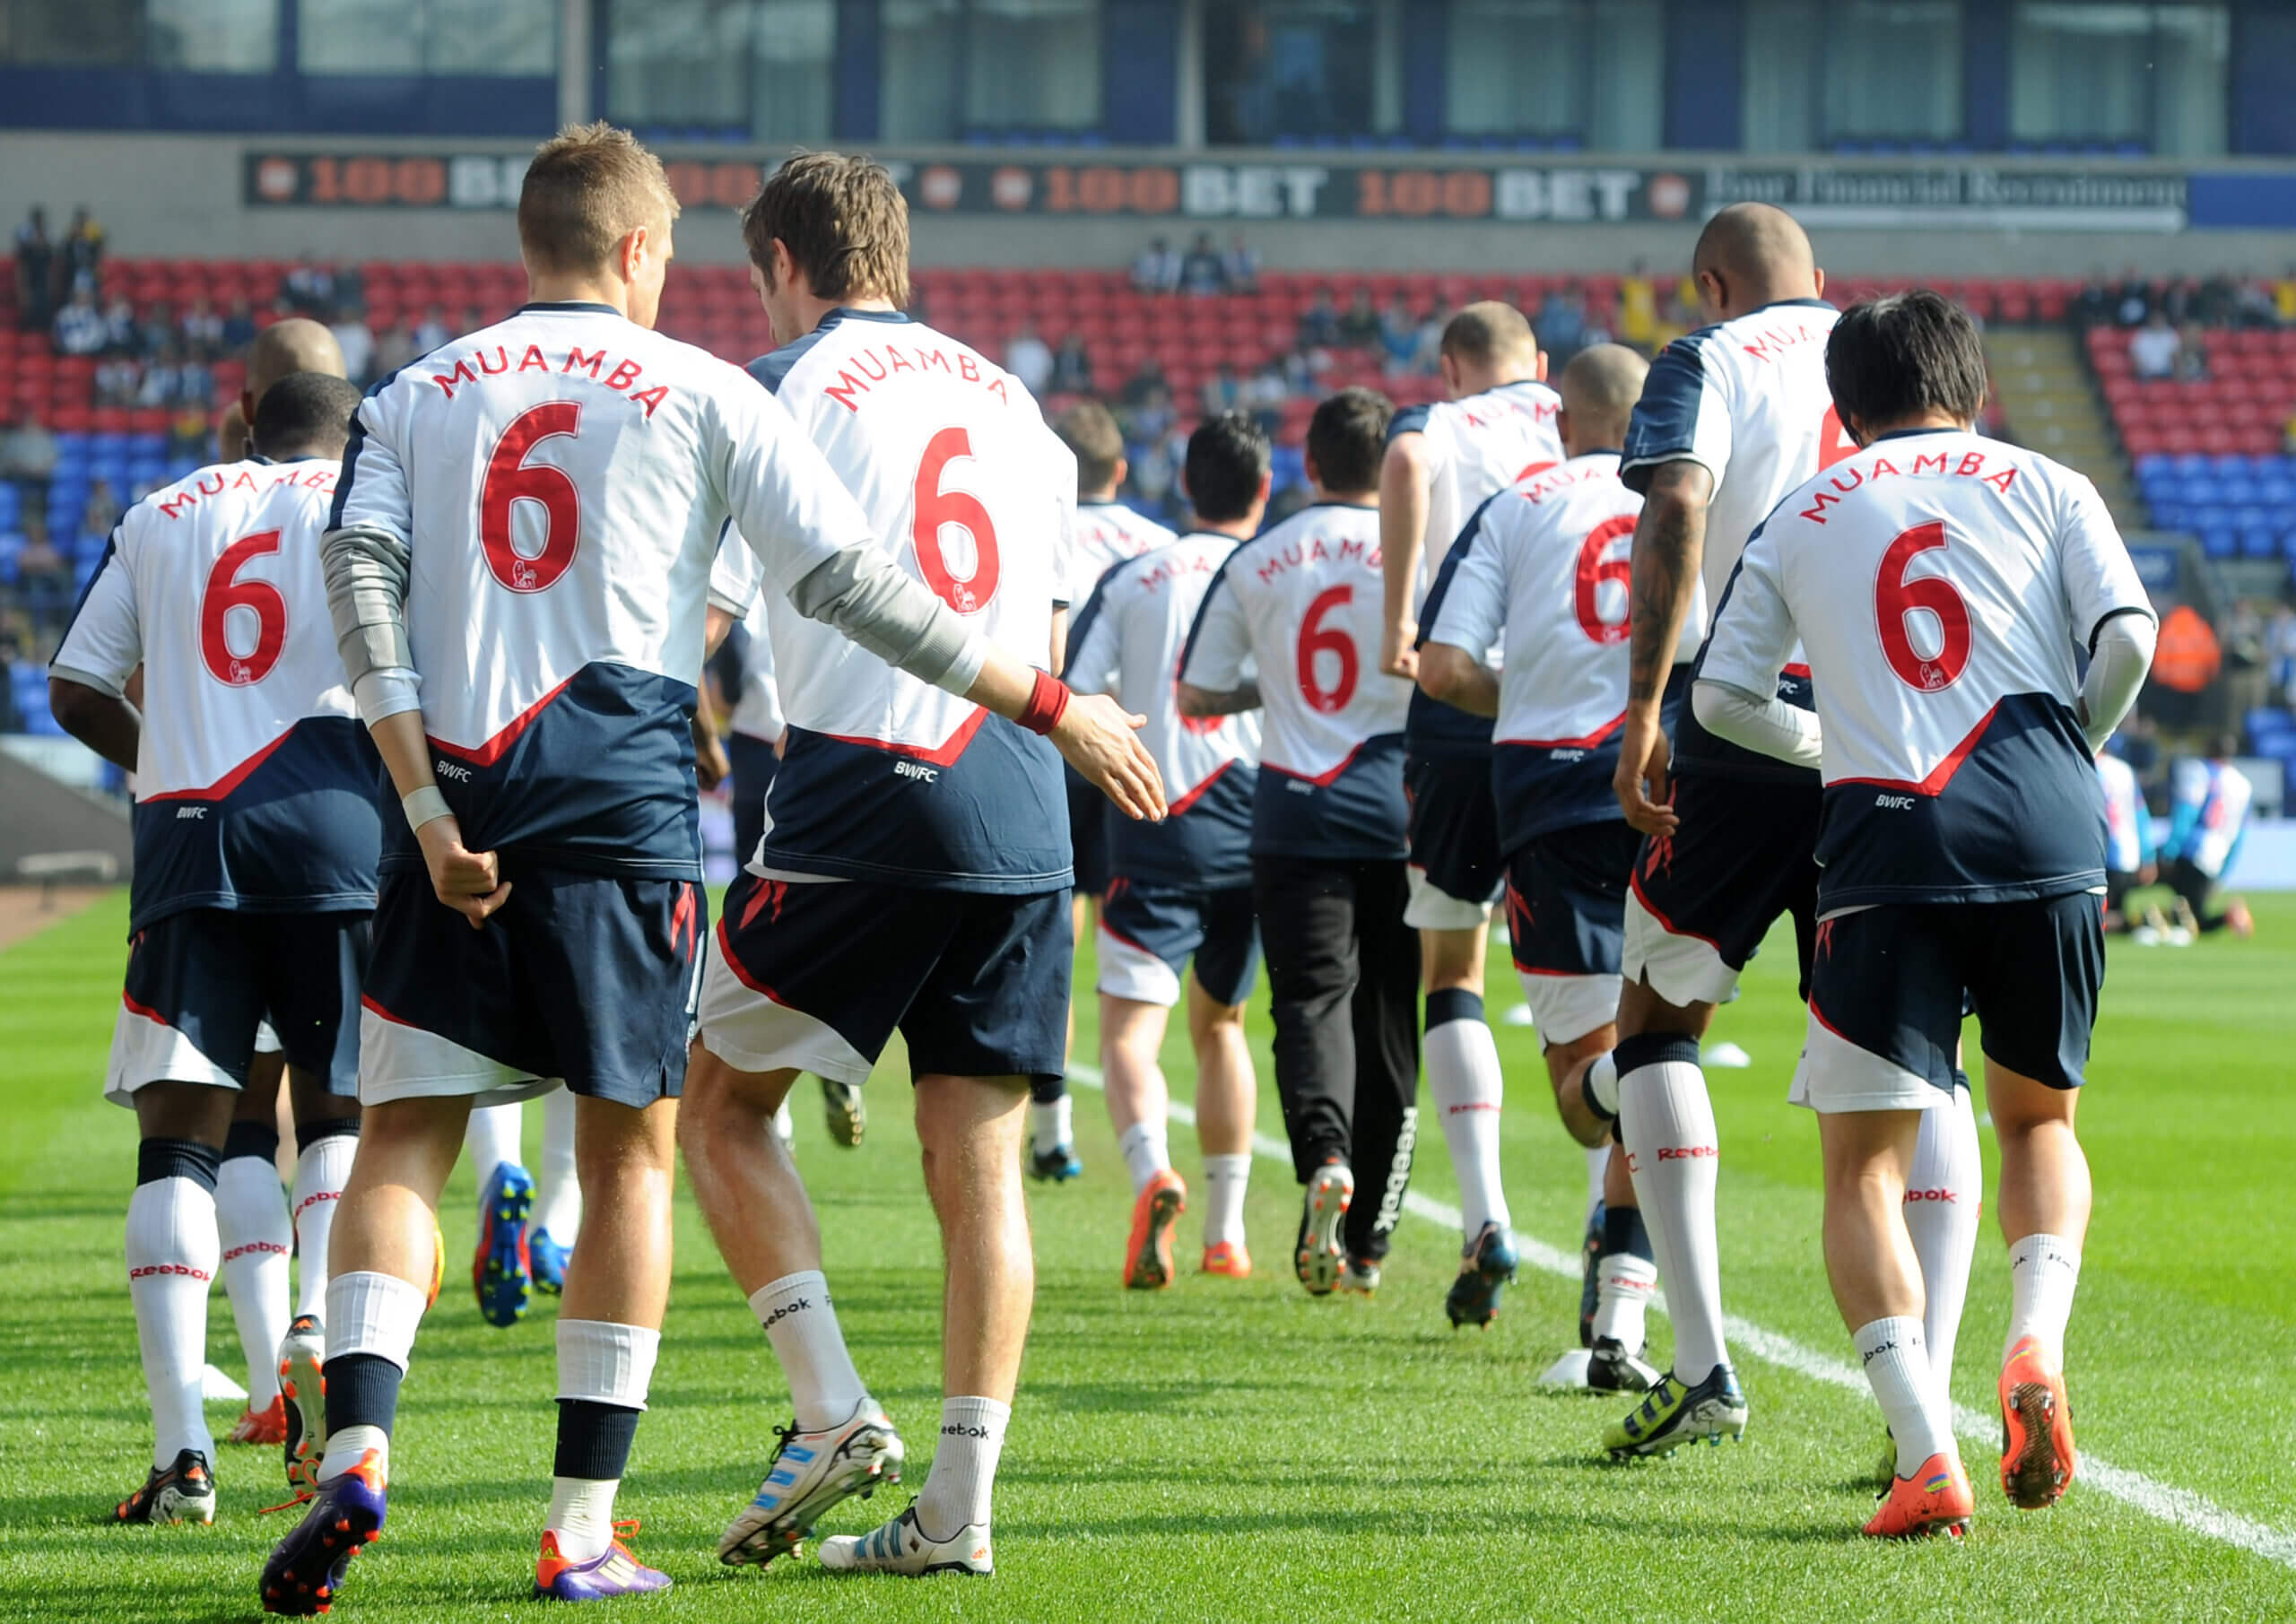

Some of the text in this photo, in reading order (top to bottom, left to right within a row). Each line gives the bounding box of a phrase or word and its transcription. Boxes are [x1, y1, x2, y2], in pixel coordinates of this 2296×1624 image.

[432, 343, 669, 419] MUAMBA
[824, 344, 1007, 413] MUAMBA
[478, 399, 583, 595] 6
[909, 424, 1002, 616] 6
[1799, 451, 2018, 525] MUAMBA
[198, 525, 289, 688] 6
[1574, 514, 1639, 647] 6
[1874, 518, 1973, 694] 6
[1296, 583, 1359, 714] 6
[437, 760, 472, 783] BWFC
[894, 760, 939, 783] BWFC
[1874, 794, 1916, 810] BWFC
[1373, 1106, 1418, 1232] Reebok
